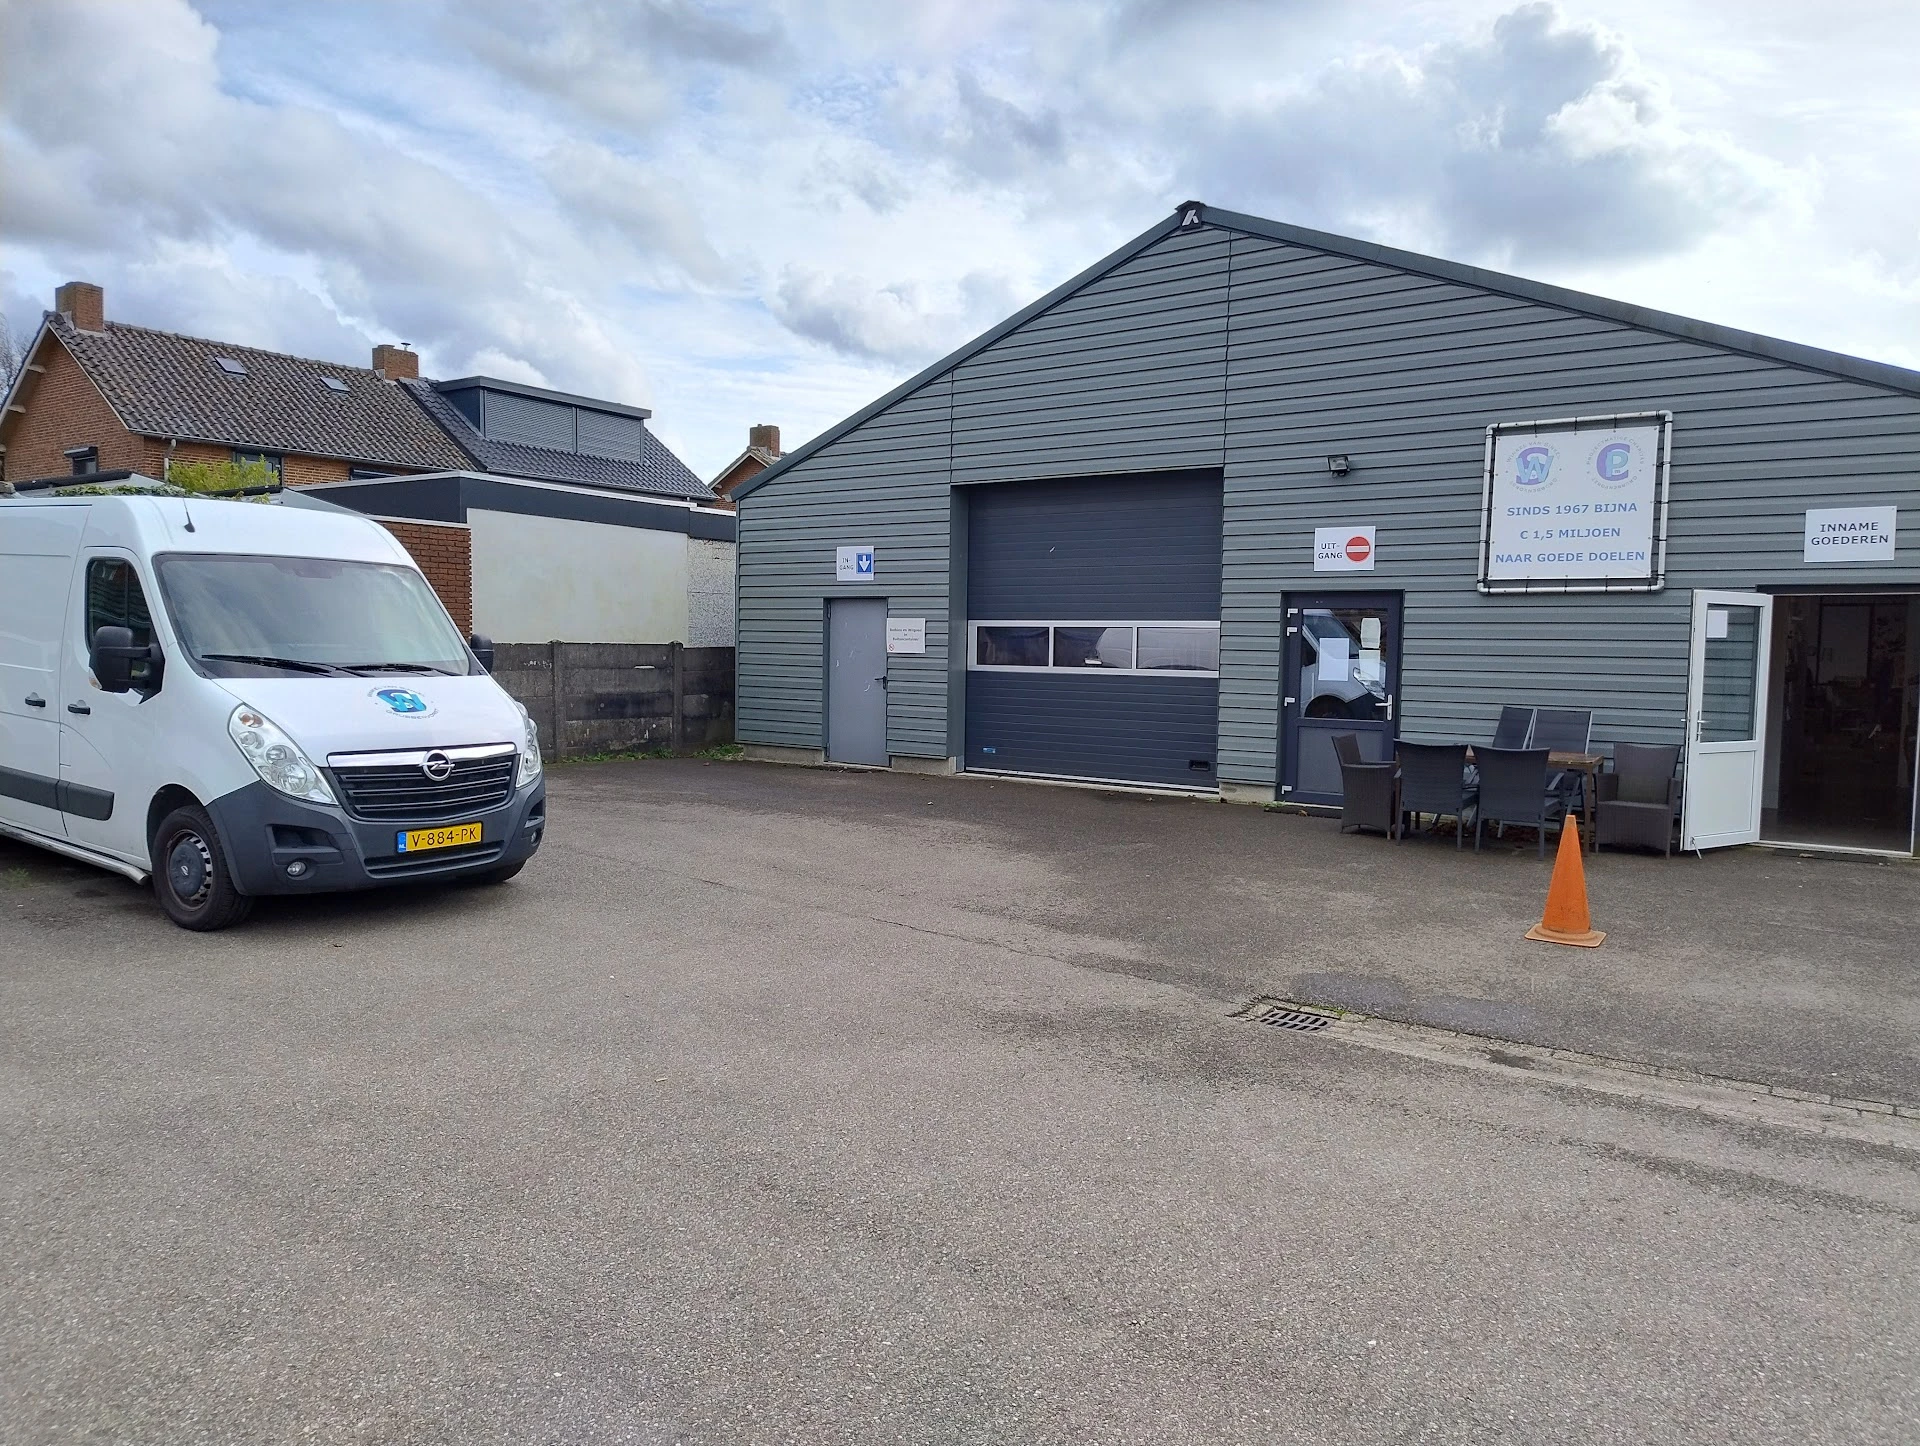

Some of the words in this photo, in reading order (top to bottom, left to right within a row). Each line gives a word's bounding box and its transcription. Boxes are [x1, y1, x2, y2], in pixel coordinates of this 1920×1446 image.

[1507, 505, 1551, 516] SINDS
[1555, 504, 1589, 515] 1967
[1594, 502, 1638, 513] BIJNA
[1820, 522, 1879, 533] INNAME
[1533, 529, 1554, 541] 1,5
[1558, 527, 1621, 539] MILJOEN
[1320, 542, 1340, 550] UIT-
[1811, 535, 1889, 546] GOEDEREN
[1317, 552, 1343, 560] GANG
[1495, 553, 1533, 563] NAAR
[1537, 552, 1584, 563] GOEDE
[1588, 551, 1645, 562] DOELEN
[412, 827, 477, 848] V-884-PK
